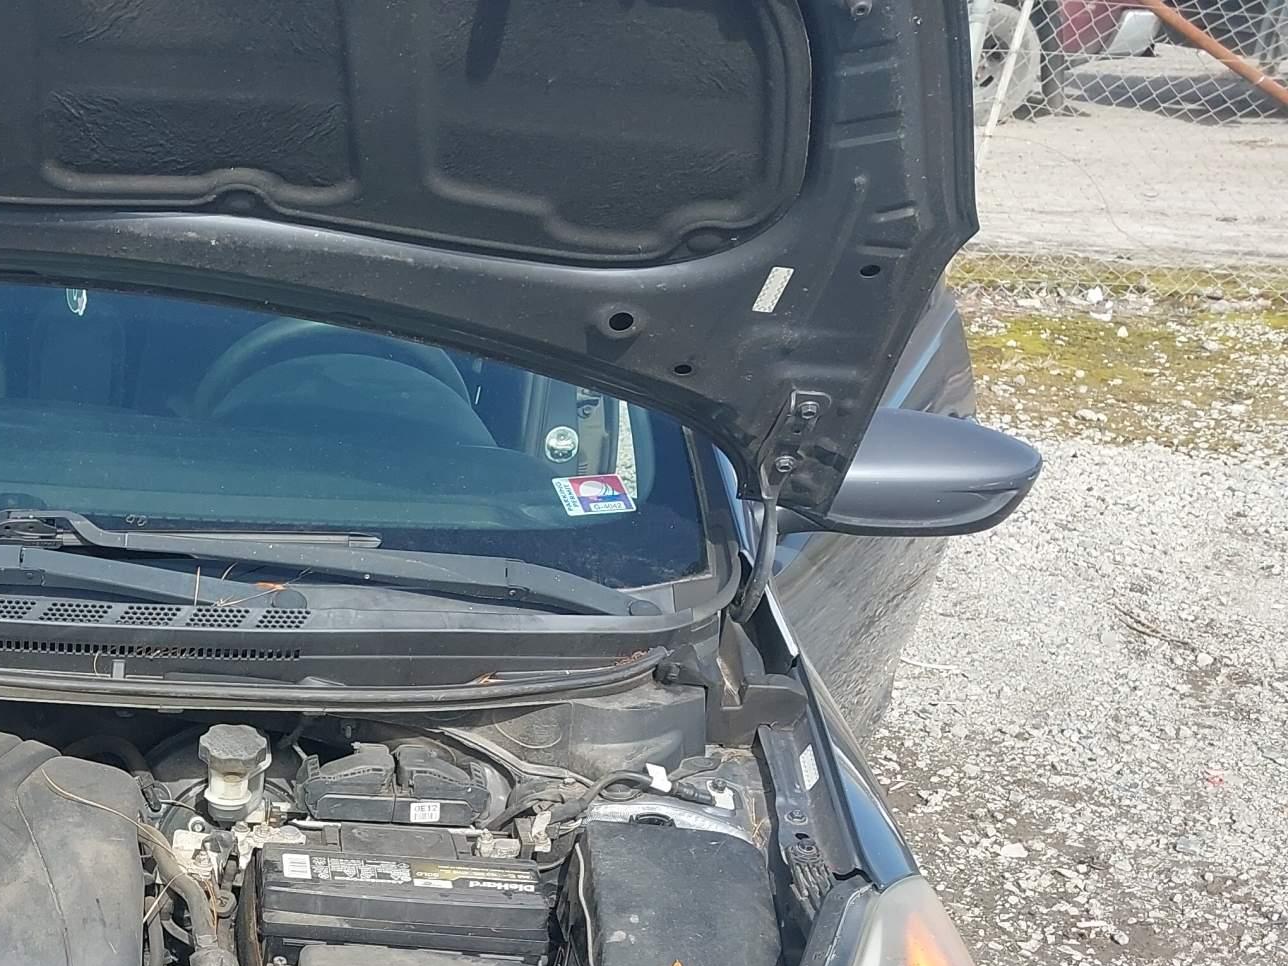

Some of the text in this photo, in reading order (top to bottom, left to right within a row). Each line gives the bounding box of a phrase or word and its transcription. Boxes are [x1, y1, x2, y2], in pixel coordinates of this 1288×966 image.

[555, 481, 573, 512] PARKING
[564, 483, 579, 508] PERMIT
[468, 880, 535, 892] DieHard
